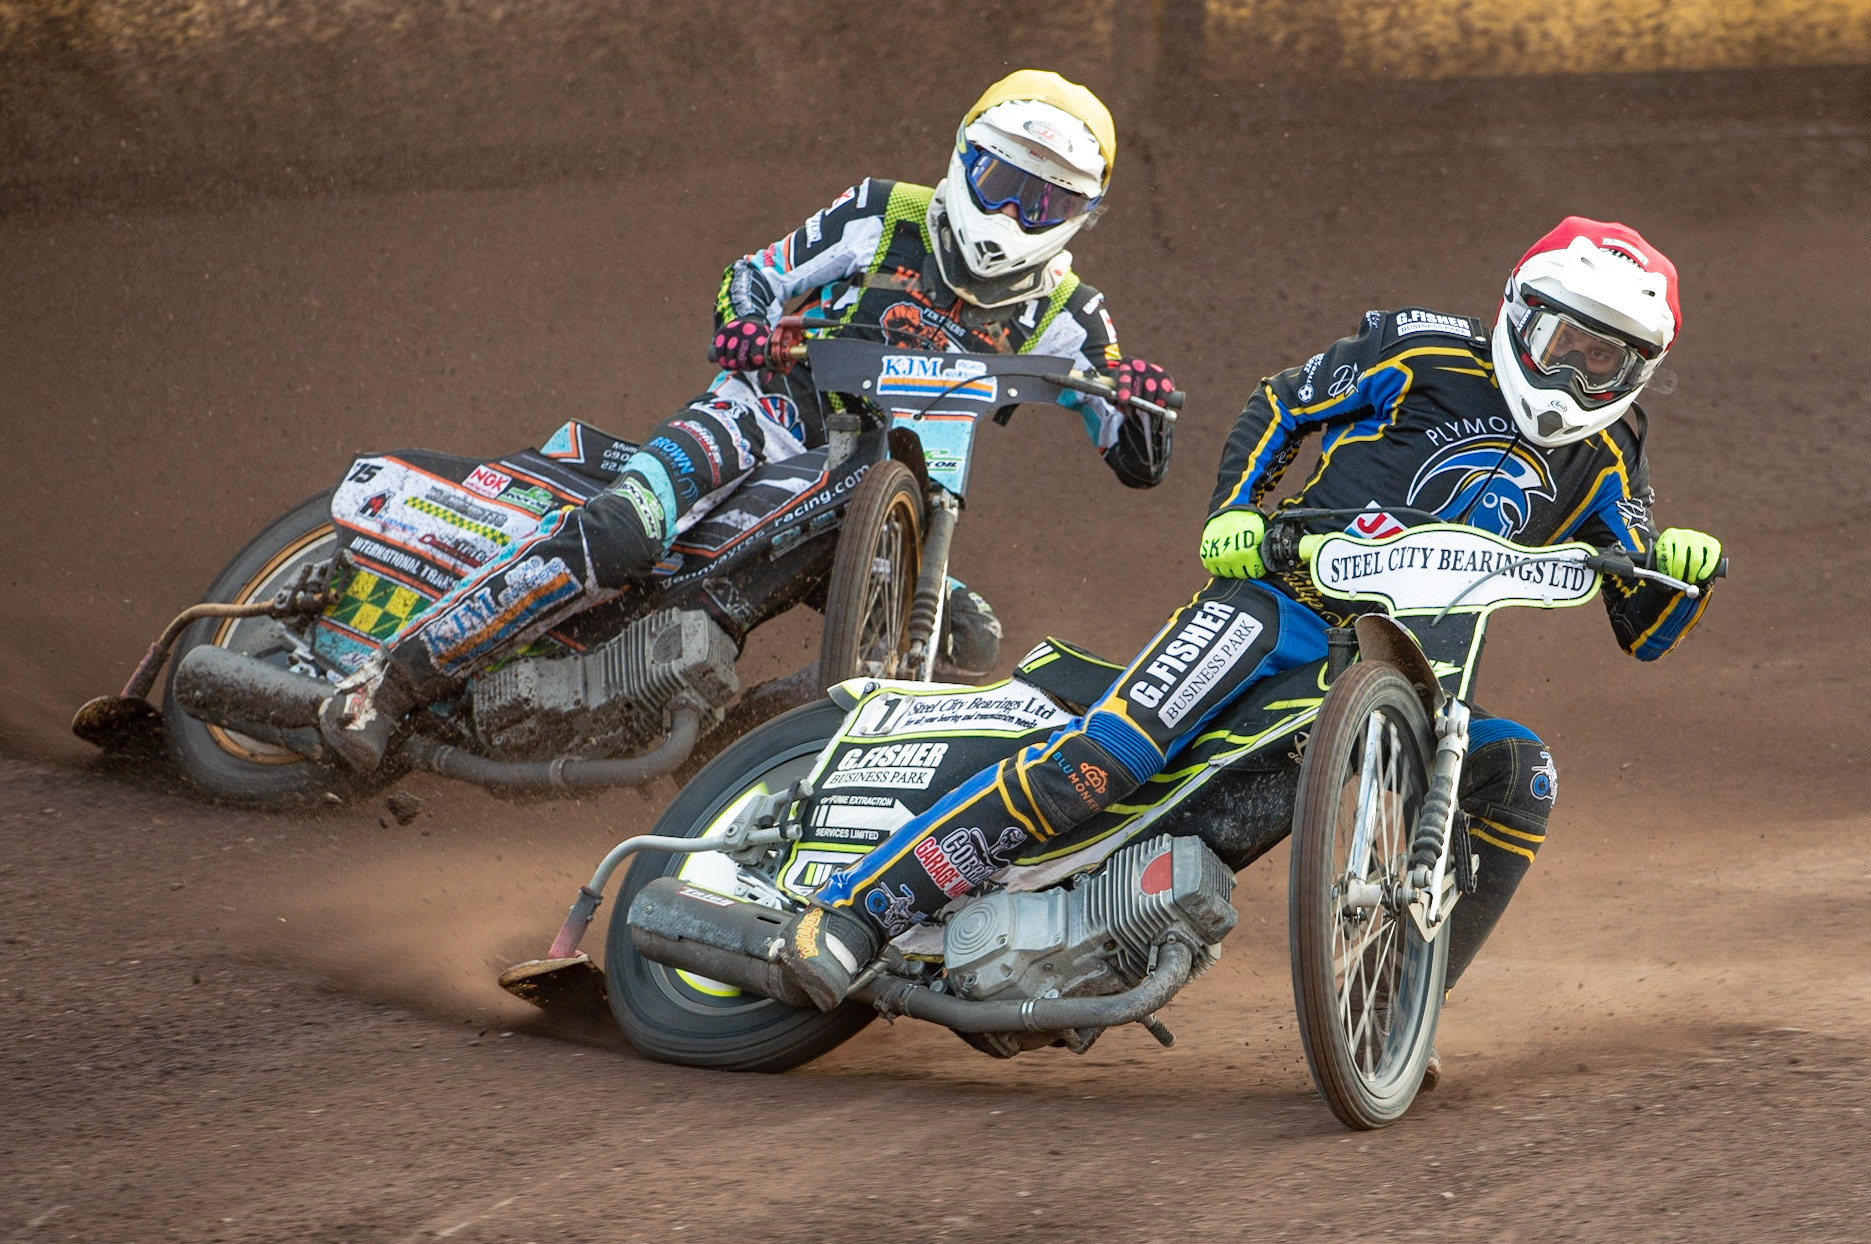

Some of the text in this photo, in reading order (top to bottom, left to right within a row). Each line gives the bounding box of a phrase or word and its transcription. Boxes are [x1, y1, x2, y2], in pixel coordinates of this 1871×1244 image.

[1396, 311, 1470, 330] G.FISHER
[1401, 324, 1442, 333] BUSINESS
[884, 358, 939, 377] KJM
[1425, 415, 1519, 447] PLYMO
[470, 468, 508, 491] NGK
[349, 535, 421, 575] INTERNATIONAL
[1330, 546, 1586, 592] STEEL CITY BEARINGS LTD
[425, 593, 496, 654] KJM
[1129, 600, 1236, 709] G.FISHER
[1166, 619, 1256, 721] BUSINESS PARK
[879, 698, 903, 732] 1
[909, 697, 1057, 720] Steel City Bearings Ltd
[837, 742, 949, 771] G.FISHER
[1053, 751, 1073, 774] BLU
[829, 770, 927, 785] BUSINESS PARK
[849, 796, 893, 806] EXTRACTION
[815, 827, 879, 840] SERVICES LIMITED
[914, 837, 960, 890] GARAGE
[941, 828, 995, 885] COBRA
